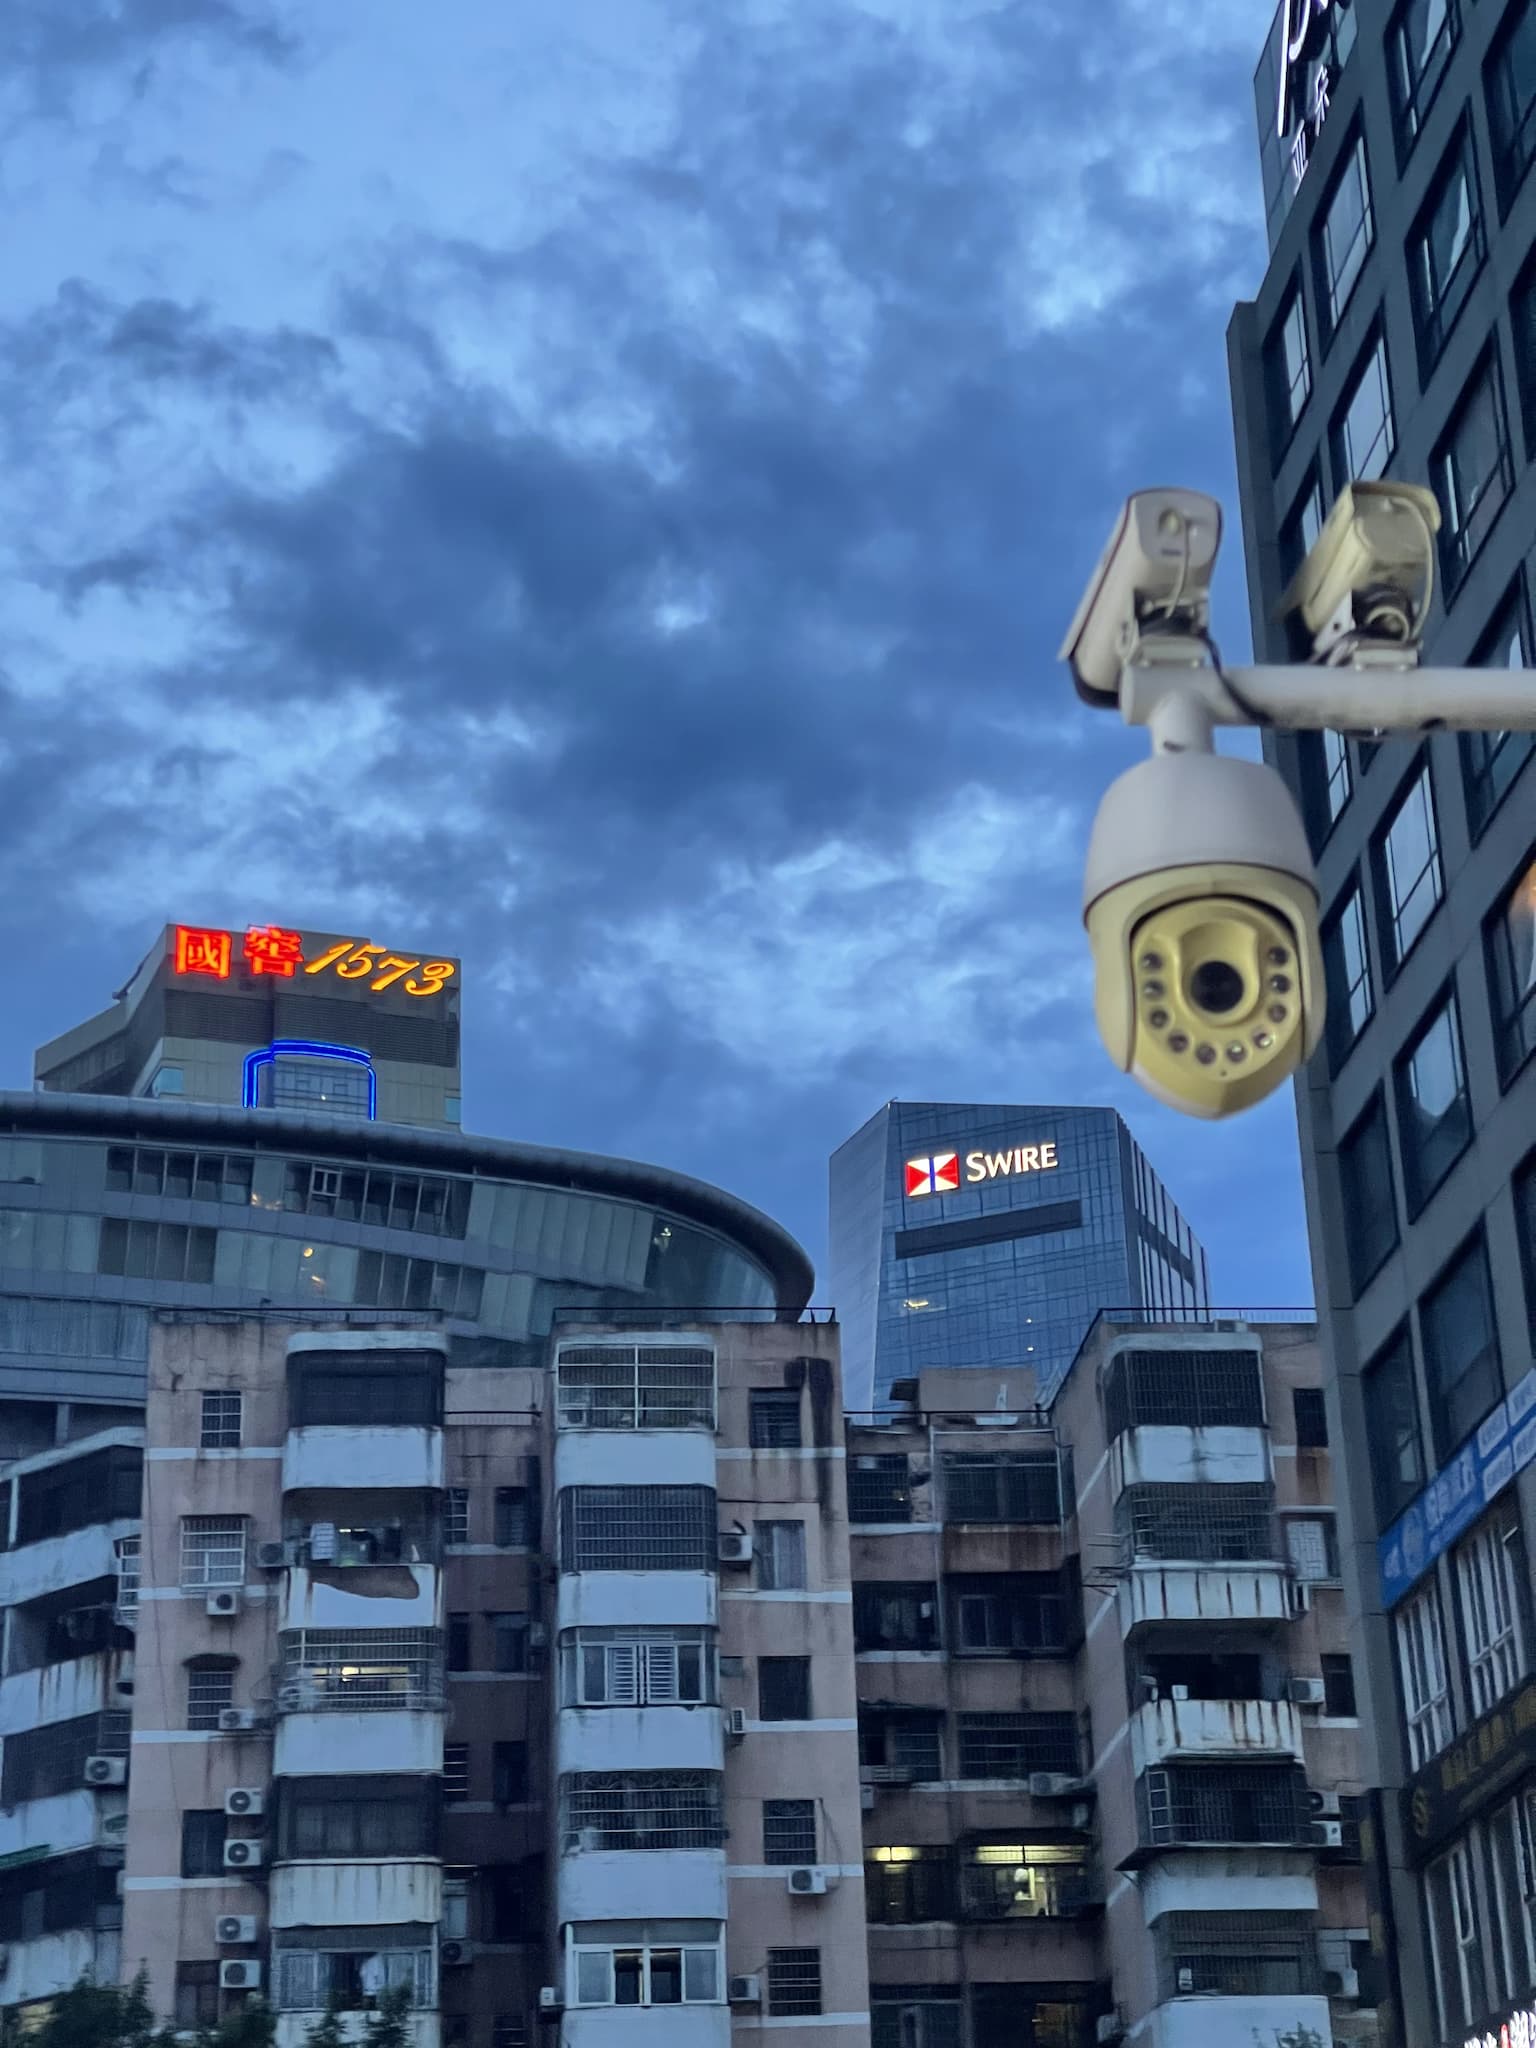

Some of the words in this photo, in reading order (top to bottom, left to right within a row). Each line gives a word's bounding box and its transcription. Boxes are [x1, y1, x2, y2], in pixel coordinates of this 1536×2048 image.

[175, 925, 303, 978] 國窖
[304, 943, 455, 995] 1573
[966, 1143, 1058, 1182] SWIRE
